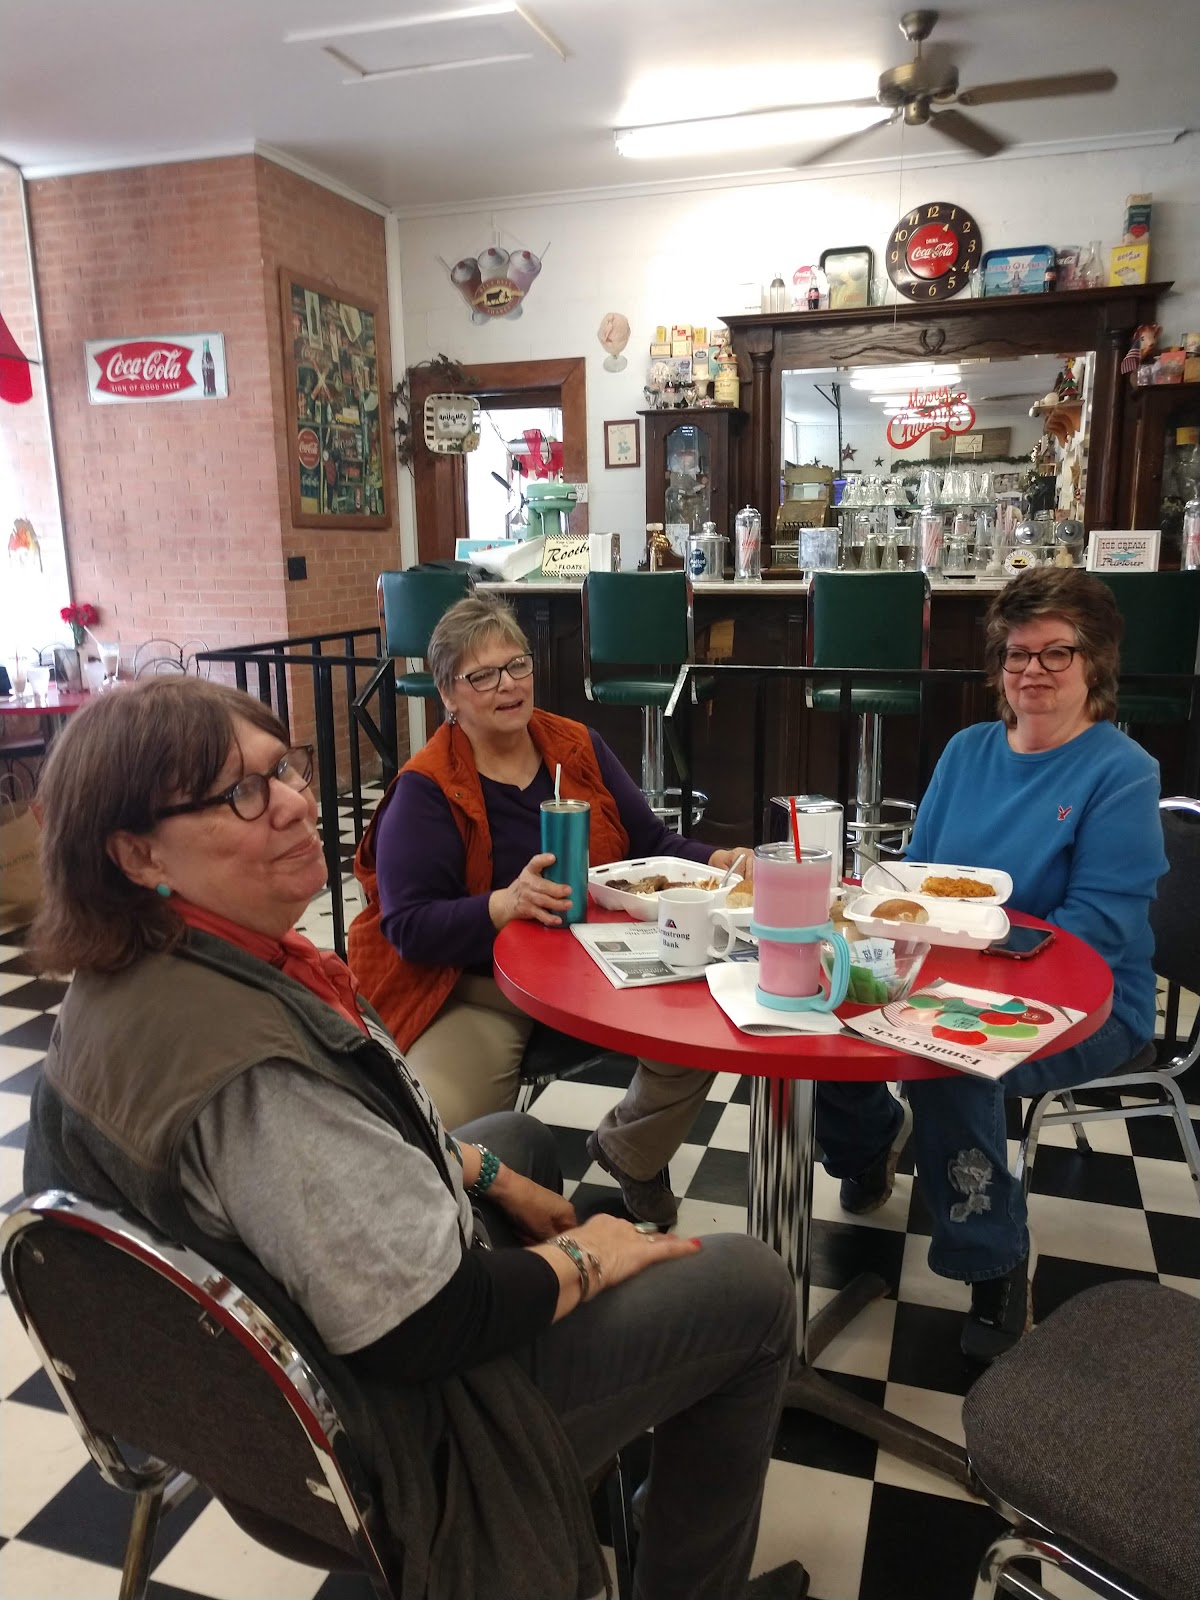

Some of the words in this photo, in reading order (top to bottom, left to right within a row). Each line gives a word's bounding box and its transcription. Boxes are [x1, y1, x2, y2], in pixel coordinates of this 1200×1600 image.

[927, 205, 940, 218] 12
[950, 208, 956, 220] 1
[909, 213, 920, 226] 11
[962, 221, 971, 233] 2
[895, 229, 908, 242] 10
[911, 241, 954, 262] Coca-Cola
[967, 239, 976, 253] 3
[891, 250, 899, 263] 9
[961, 259, 970, 273] 4
[910, 282, 918, 294] 7
[947, 275, 956, 289] 5
[928, 283, 937, 297] 6
[106, 348, 182, 382] Coca-Cola
[111, 383, 128, 393] SIGN
[129, 384, 138, 392] OF
[140, 383, 160, 392] GOOD
[162, 382, 181, 390] TASTE
[1101, 541, 1116, 550] ICE
[1117, 541, 1146, 550] CREAM
[558, 562, 582, 571] FLOATS
[662, 938, 680, 949] Bank
